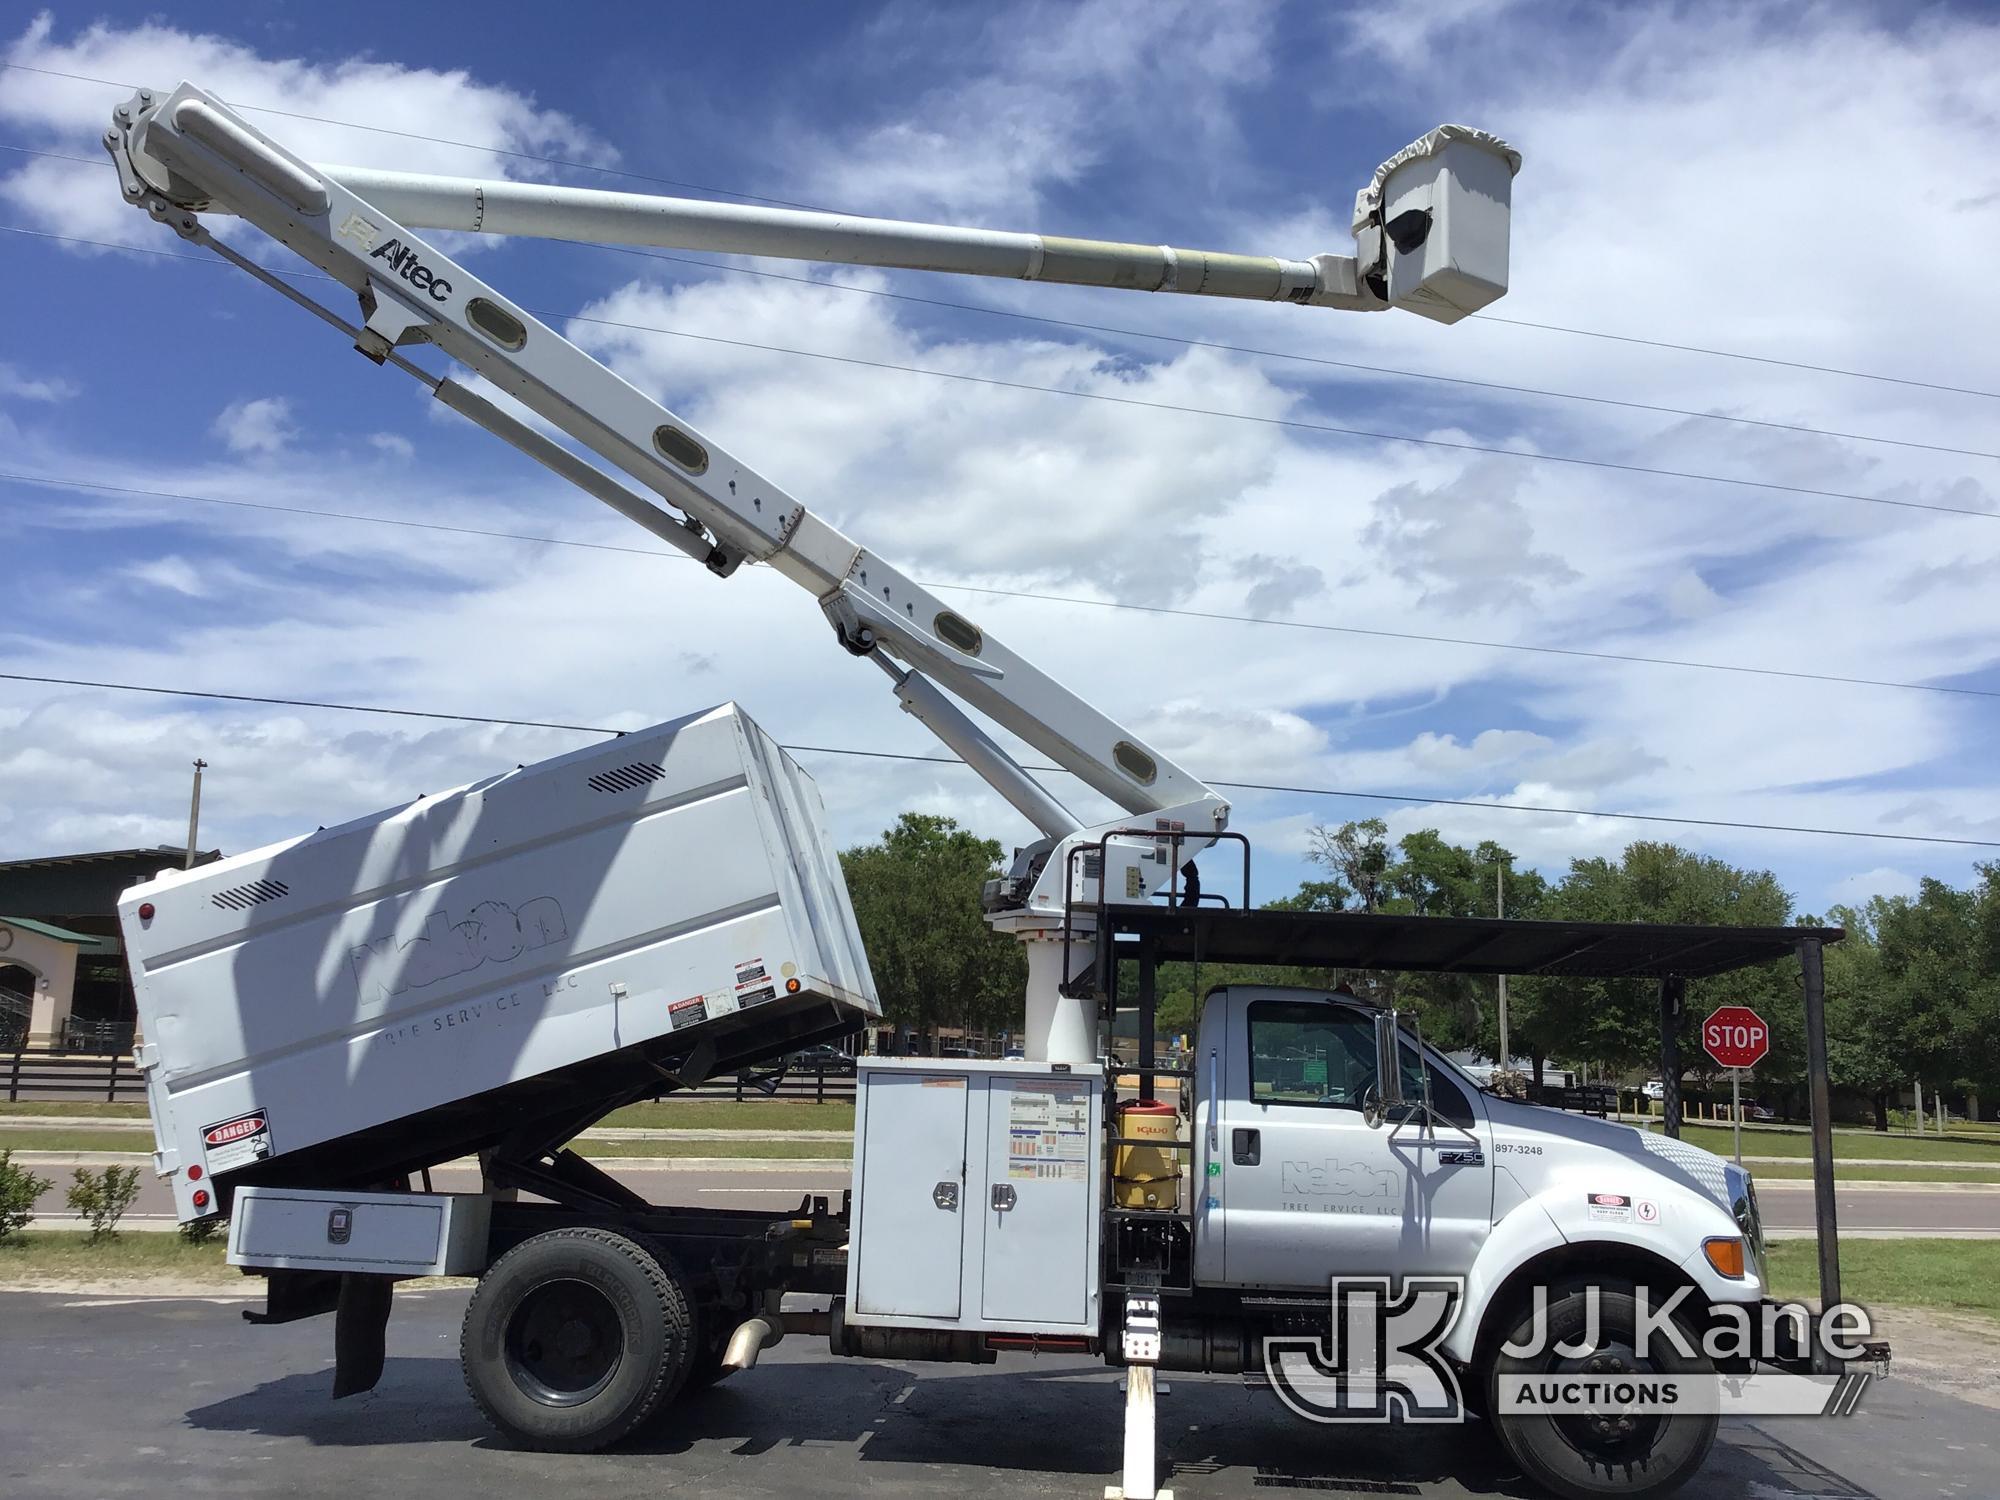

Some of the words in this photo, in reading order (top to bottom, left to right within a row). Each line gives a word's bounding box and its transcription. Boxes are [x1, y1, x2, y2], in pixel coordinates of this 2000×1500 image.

[370, 238, 453, 303] Altec
[433, 992, 521, 1032] SERVCE
[1707, 1025, 1764, 1049] STOP
[215, 1120, 256, 1142] DANGER
[1495, 1143, 1543, 1156] 897-3248
[1377, 1207, 1397, 1215] LLC
